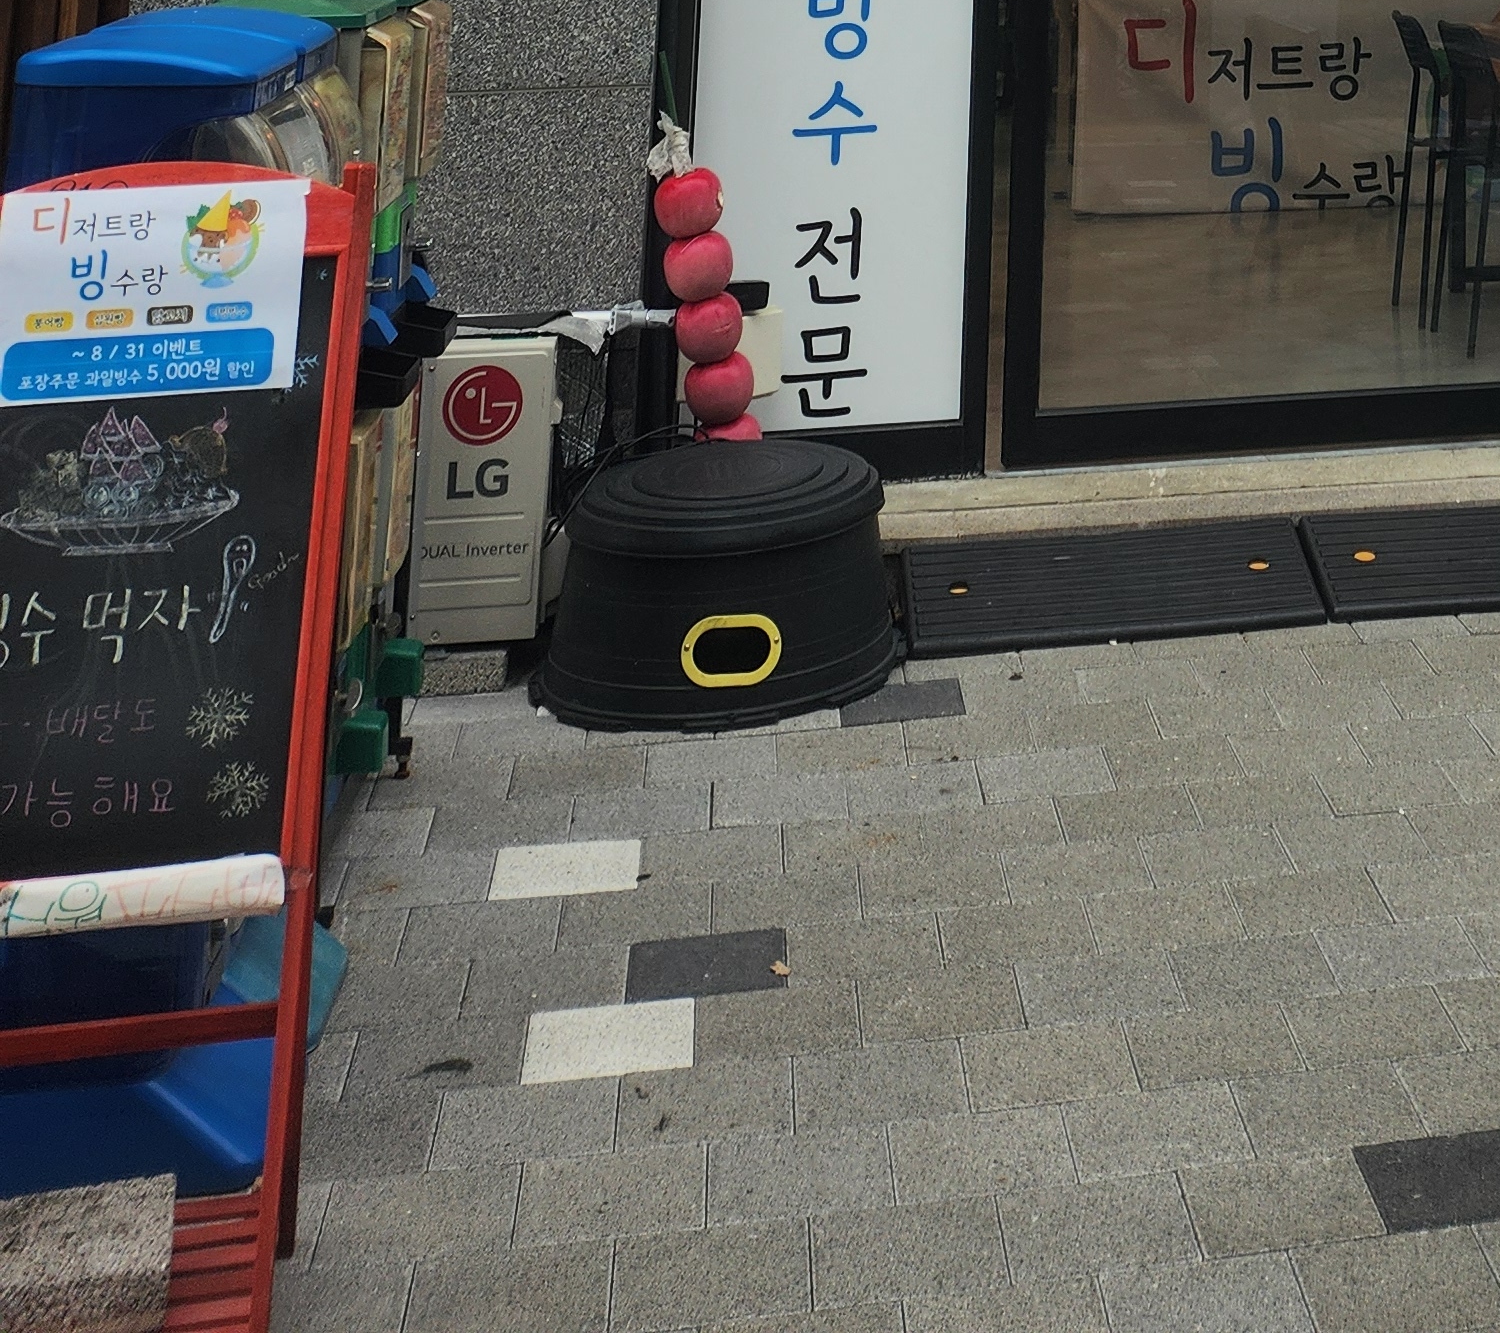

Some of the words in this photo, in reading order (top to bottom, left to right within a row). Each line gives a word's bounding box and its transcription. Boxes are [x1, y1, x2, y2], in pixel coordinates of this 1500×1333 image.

[33, 197, 156, 245] 디저트랑
[71, 249, 168, 301] 빙수랑
[781, 206, 868, 418] 전문
[152, 339, 204, 360] 이벤트
[17, 372, 80, 391] 포장주문
[86, 369, 142, 387] 과일빙수
[146, 358, 220, 384] 5,000원
[227, 361, 254, 378] 할인
[445, 459, 510, 501] LG
[465, 542, 529, 558] Inverter
[83, 585, 201, 664] 먹자
[46, 699, 156, 743] 배달도
[1, 777, 175, 828] 가능해요
